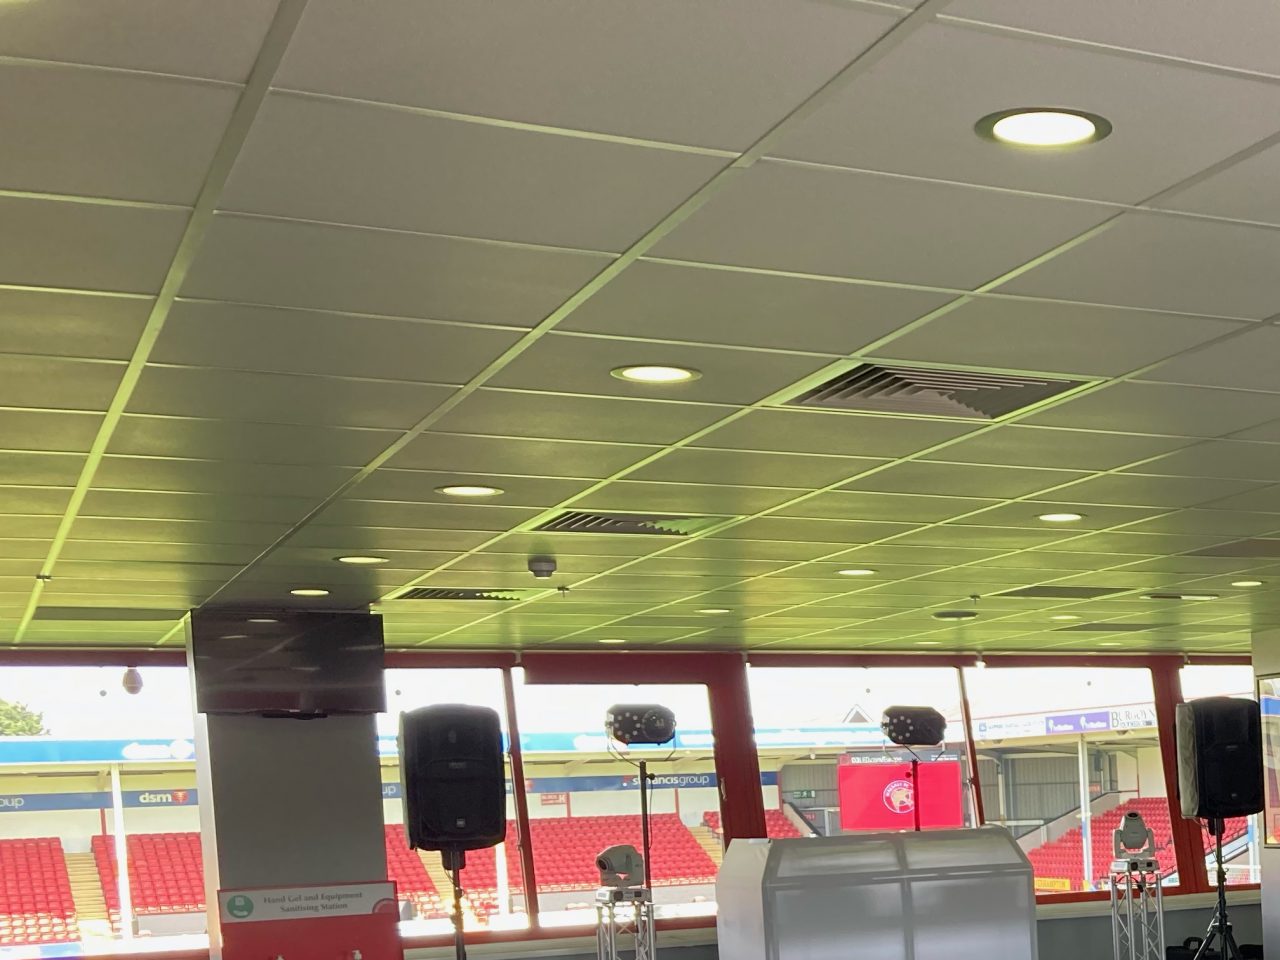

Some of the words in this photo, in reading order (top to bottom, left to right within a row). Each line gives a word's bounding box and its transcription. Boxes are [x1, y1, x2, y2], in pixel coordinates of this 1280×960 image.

[139, 792, 172, 803] dsm
[264, 895, 285, 904] Hand
[288, 894, 301, 902] Gel
[304, 893, 318, 901] and
[321, 892, 362, 901] Equipment
[321, 903, 348, 911] Station
